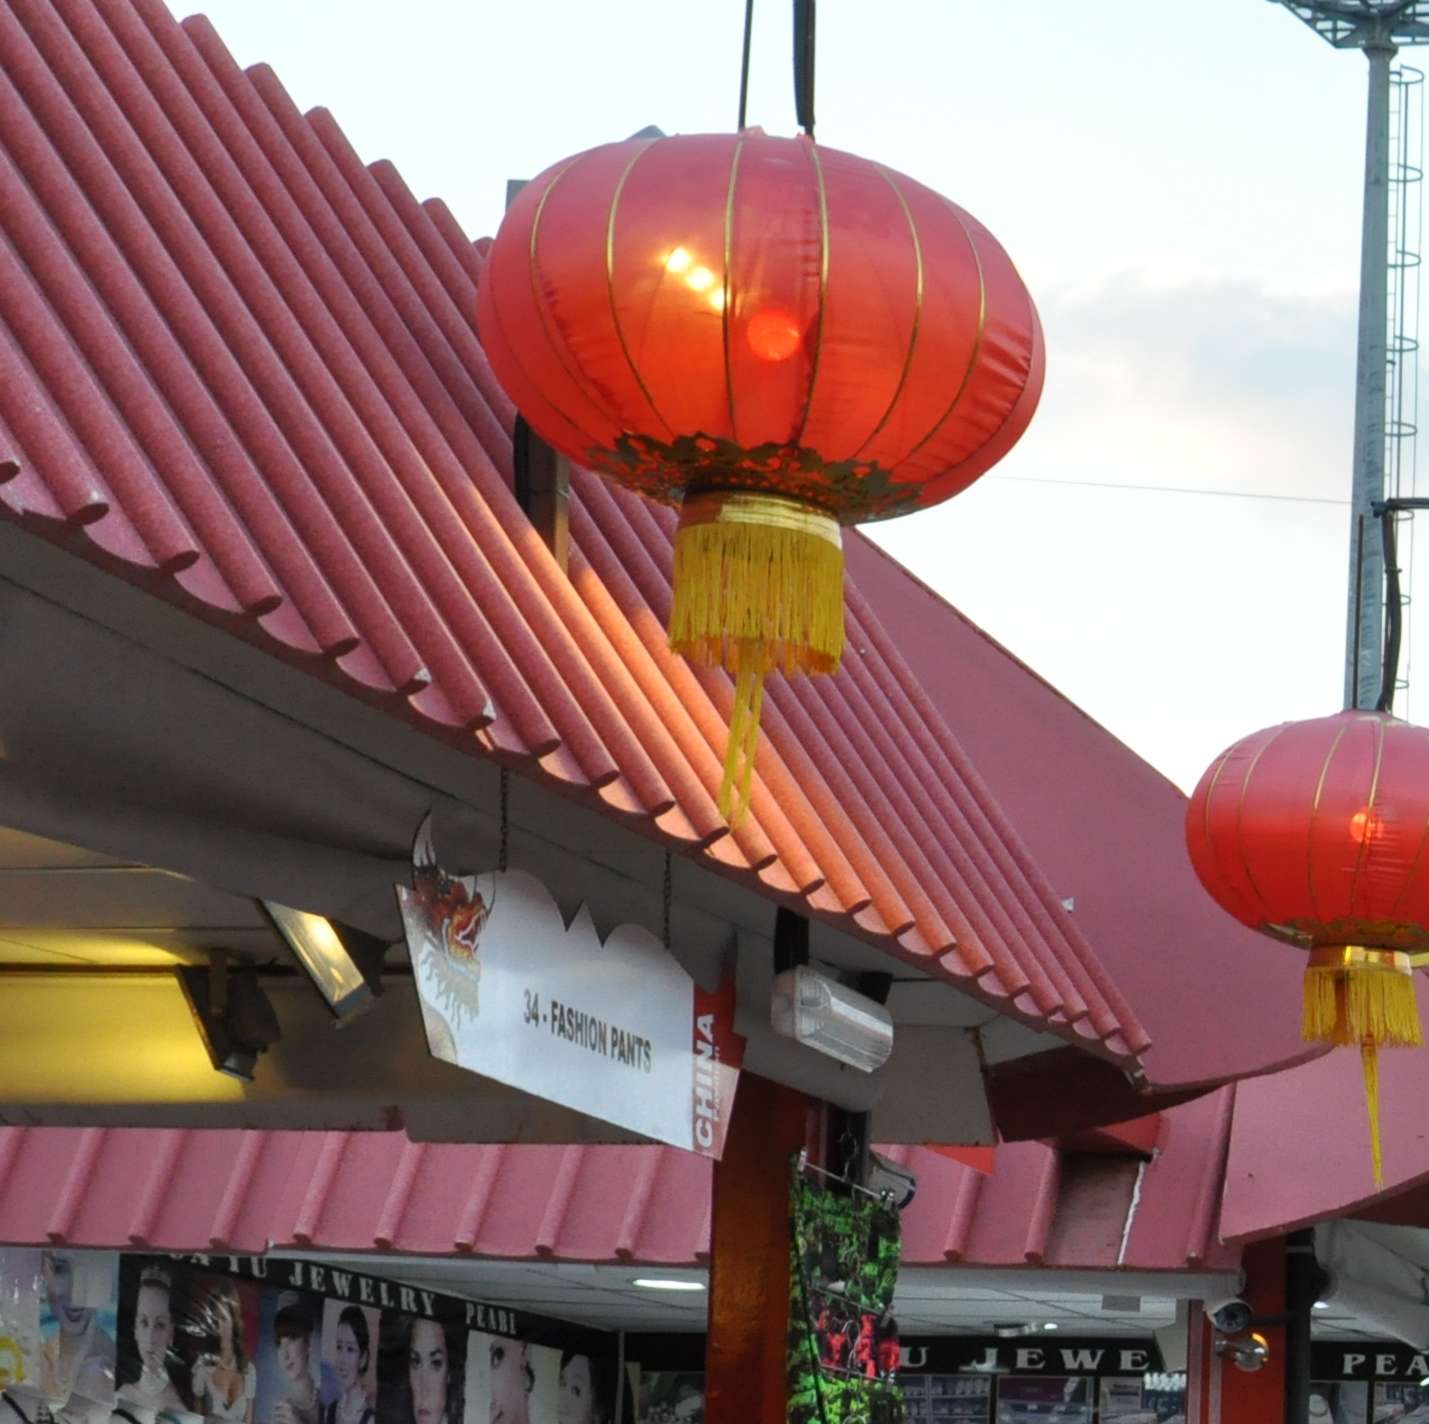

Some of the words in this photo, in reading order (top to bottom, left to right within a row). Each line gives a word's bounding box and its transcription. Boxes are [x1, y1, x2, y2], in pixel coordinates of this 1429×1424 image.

[524, 989, 539, 1027] 34
[551, 1000, 607, 1056] FASHION
[611, 1026, 652, 1072] PANTS
[695, 1014, 714, 1148] CHINA
[287, 1261, 437, 1317] JEWELRY
[465, 1301, 517, 1335] PEARL
